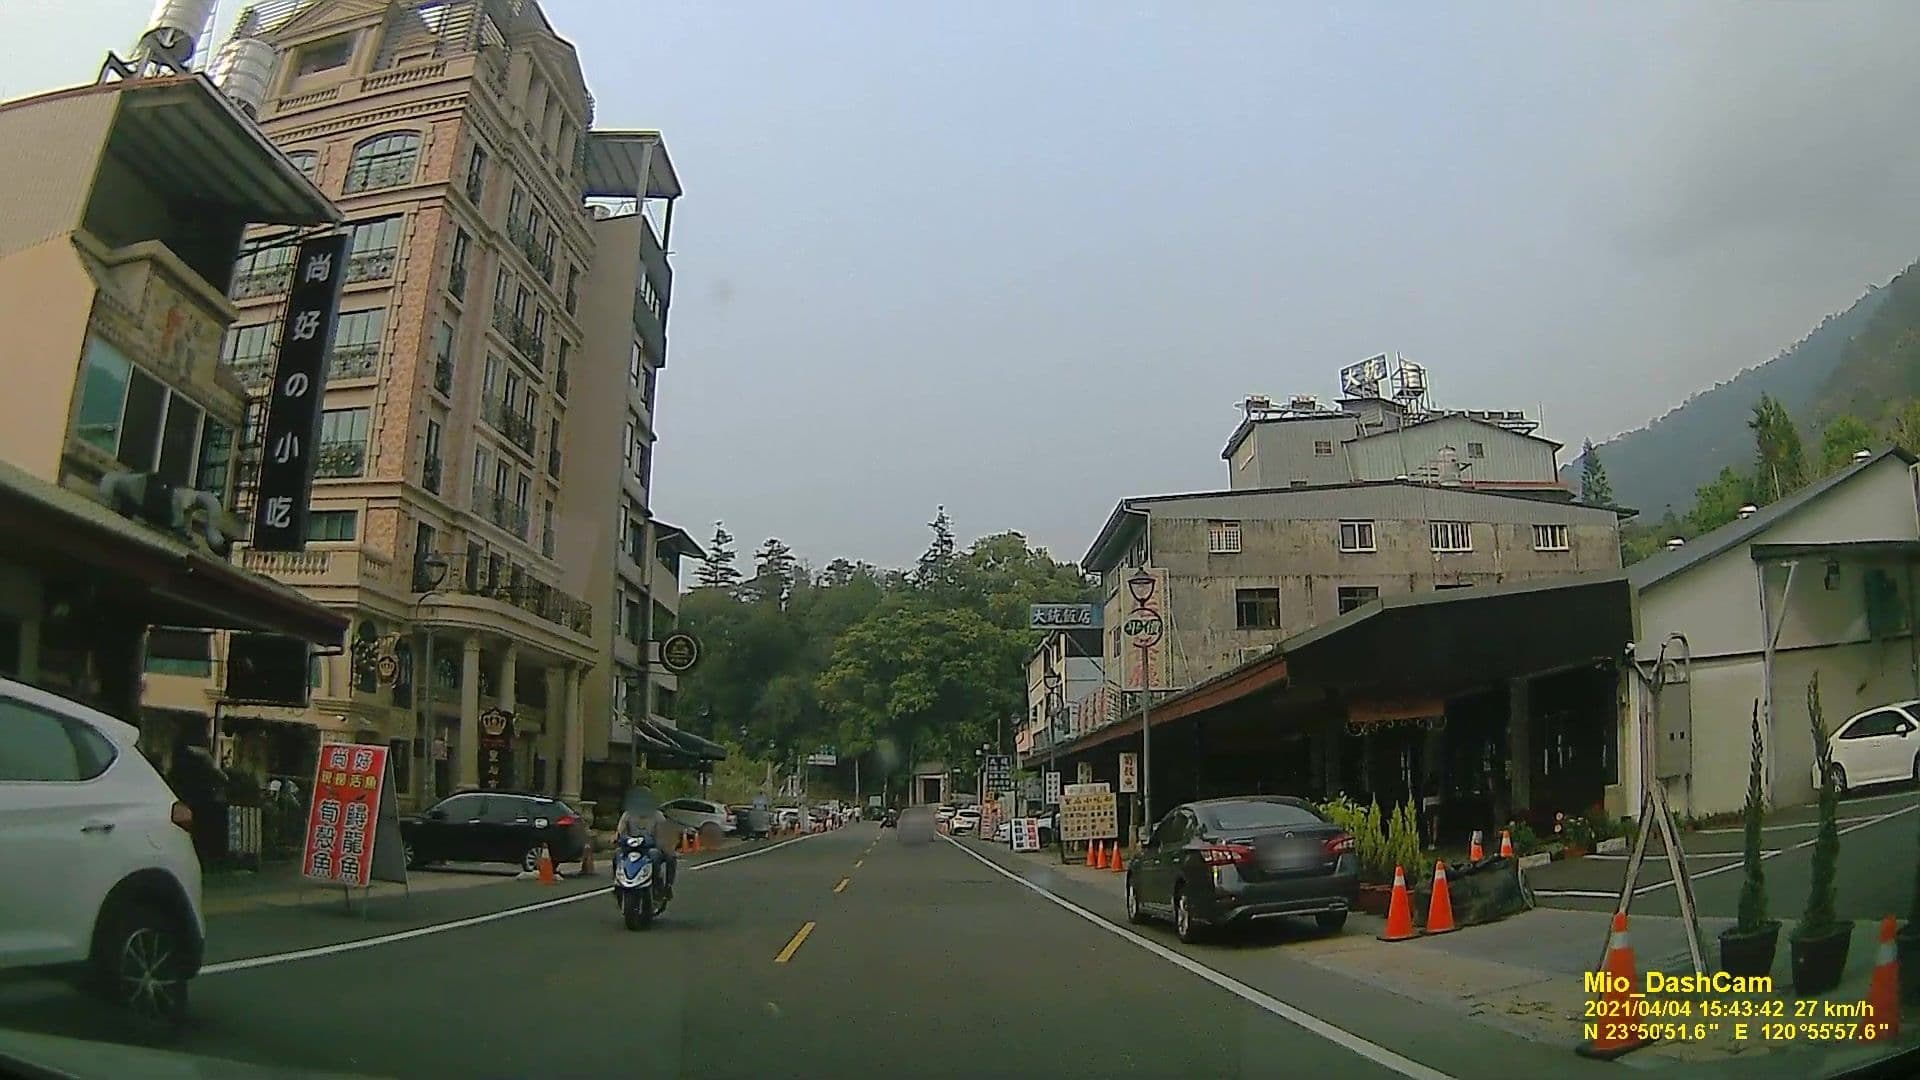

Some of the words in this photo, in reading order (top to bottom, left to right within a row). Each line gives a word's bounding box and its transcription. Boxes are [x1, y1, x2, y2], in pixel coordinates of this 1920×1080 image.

[266, 252, 332, 528] 尚好の小吃
[330, 747, 374, 772] 尚好
[312, 799, 342, 878] 筍殼魚
